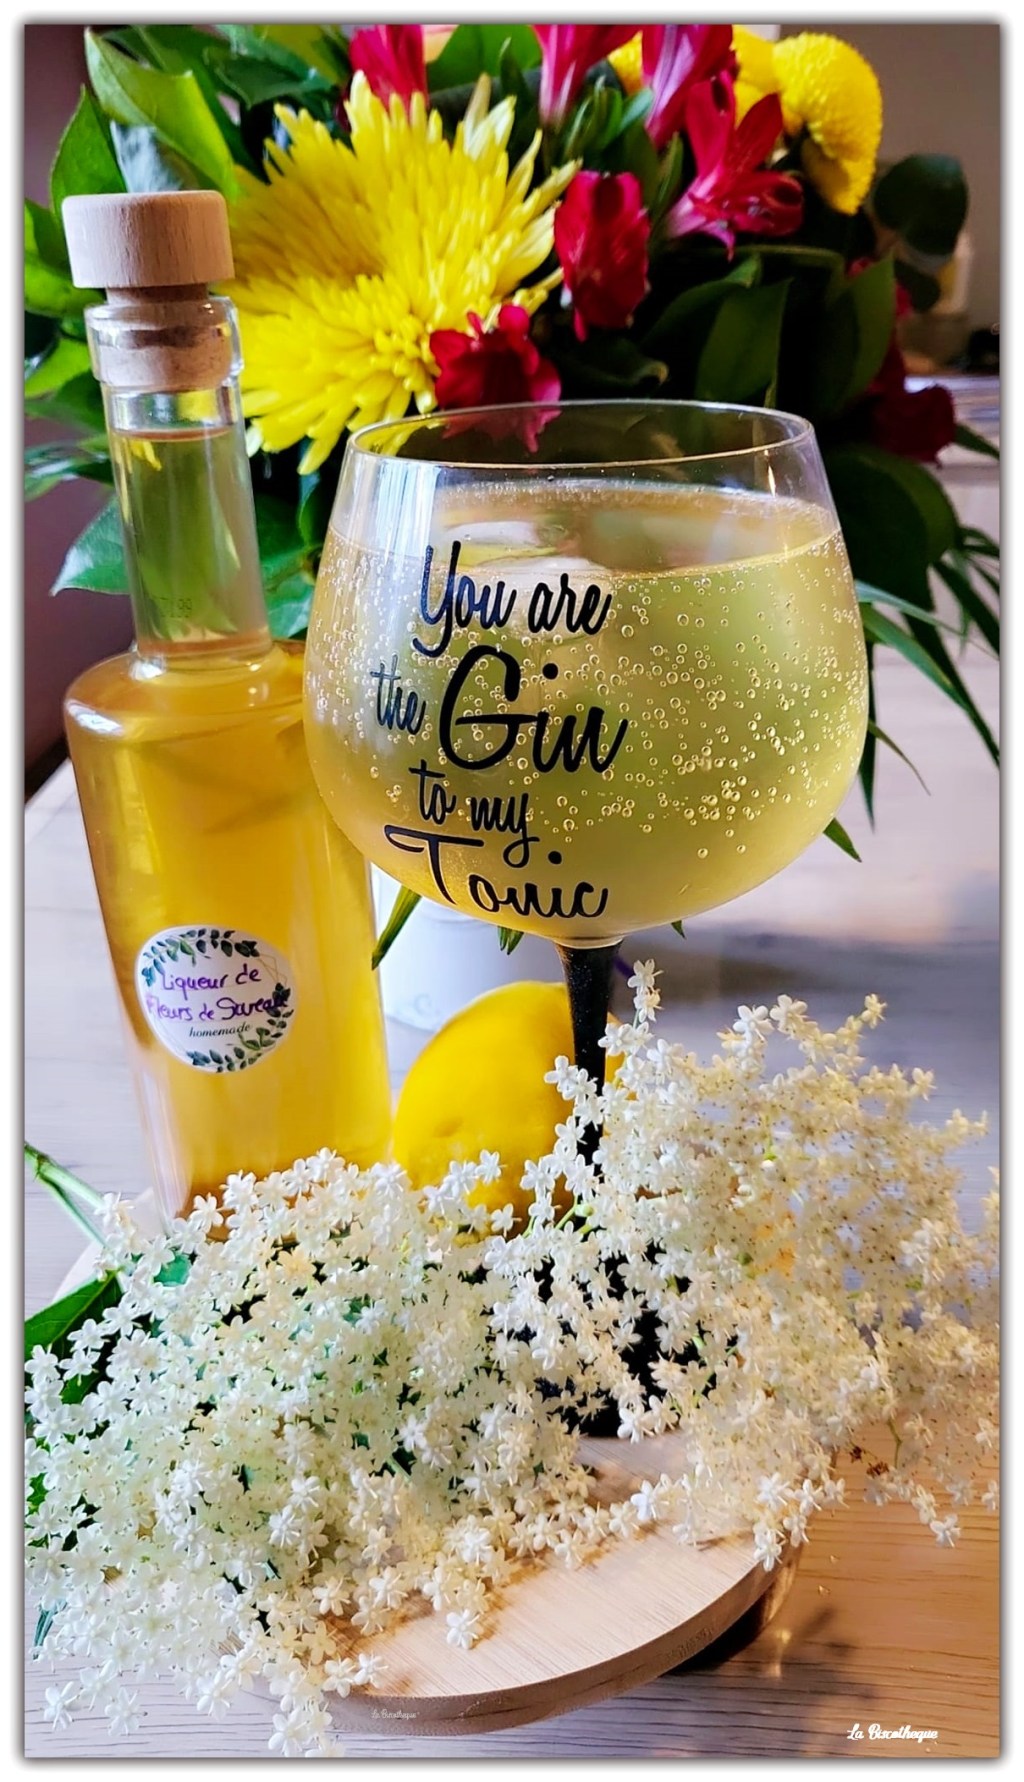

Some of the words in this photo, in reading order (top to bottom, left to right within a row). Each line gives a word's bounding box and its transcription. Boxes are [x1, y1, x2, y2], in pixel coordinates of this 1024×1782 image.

[412, 540, 517, 658] You
[528, 573, 613, 635] are
[370, 654, 426, 735] the
[439, 645, 628, 773] Gin
[408, 759, 456, 825] to
[471, 793, 540, 868] my
[384, 825, 609, 918] Tonic
[145, 994, 193, 1021] Fleurs
[198, 1003, 215, 1021] de
[161, 970, 228, 1001] Liqueur
[235, 963, 262, 985] de
[189, 1022, 251, 1038] homemade
